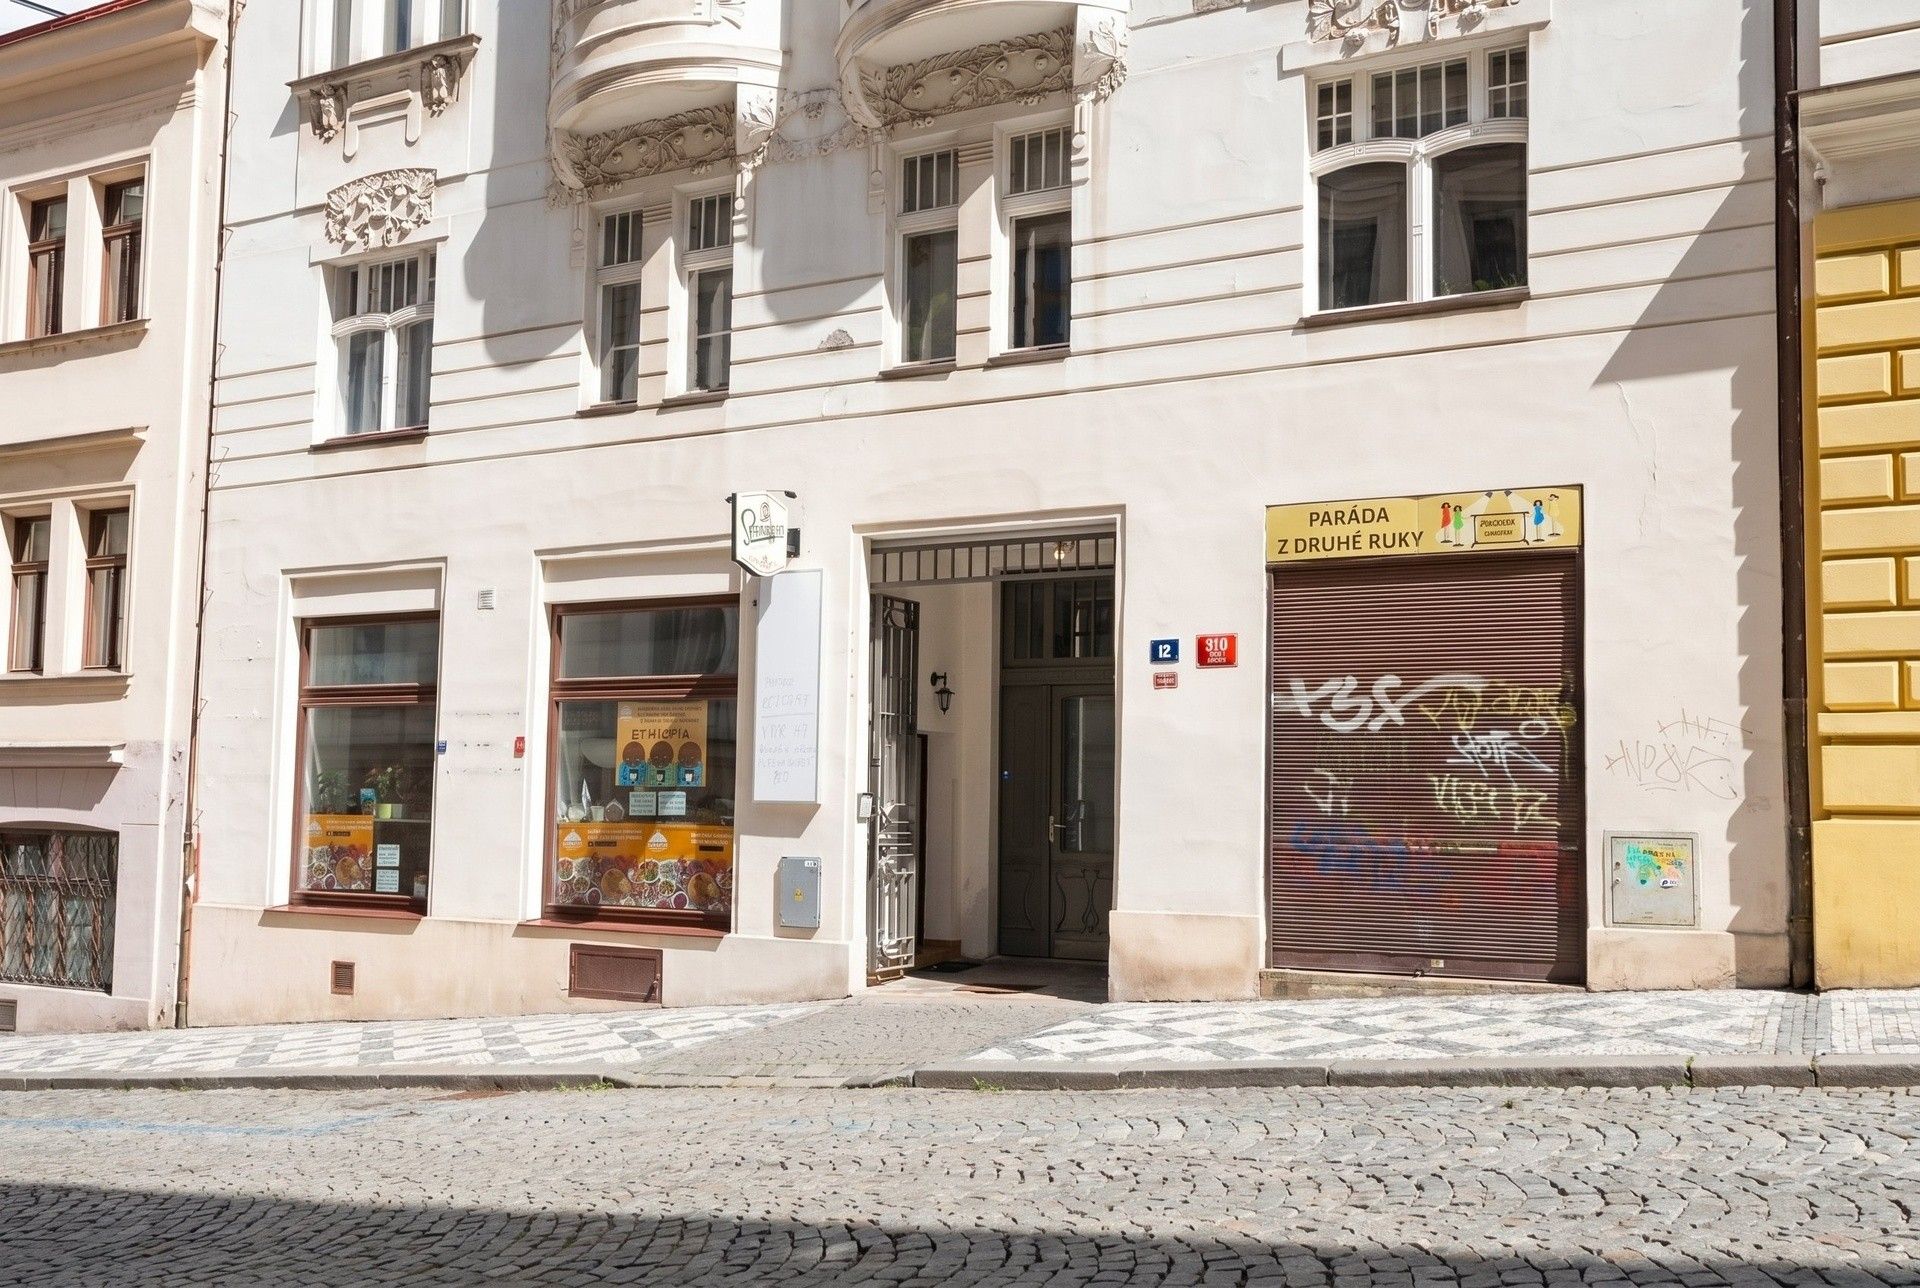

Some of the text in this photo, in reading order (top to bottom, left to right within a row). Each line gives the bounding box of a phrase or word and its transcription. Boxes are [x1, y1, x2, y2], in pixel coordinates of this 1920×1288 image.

[1309, 504, 1389, 527] PARÁDA
[1277, 530, 1424, 555] Z DRUHÉ RUKY
[1158, 644, 1171, 658] 12
[1205, 637, 1228, 652] 310
